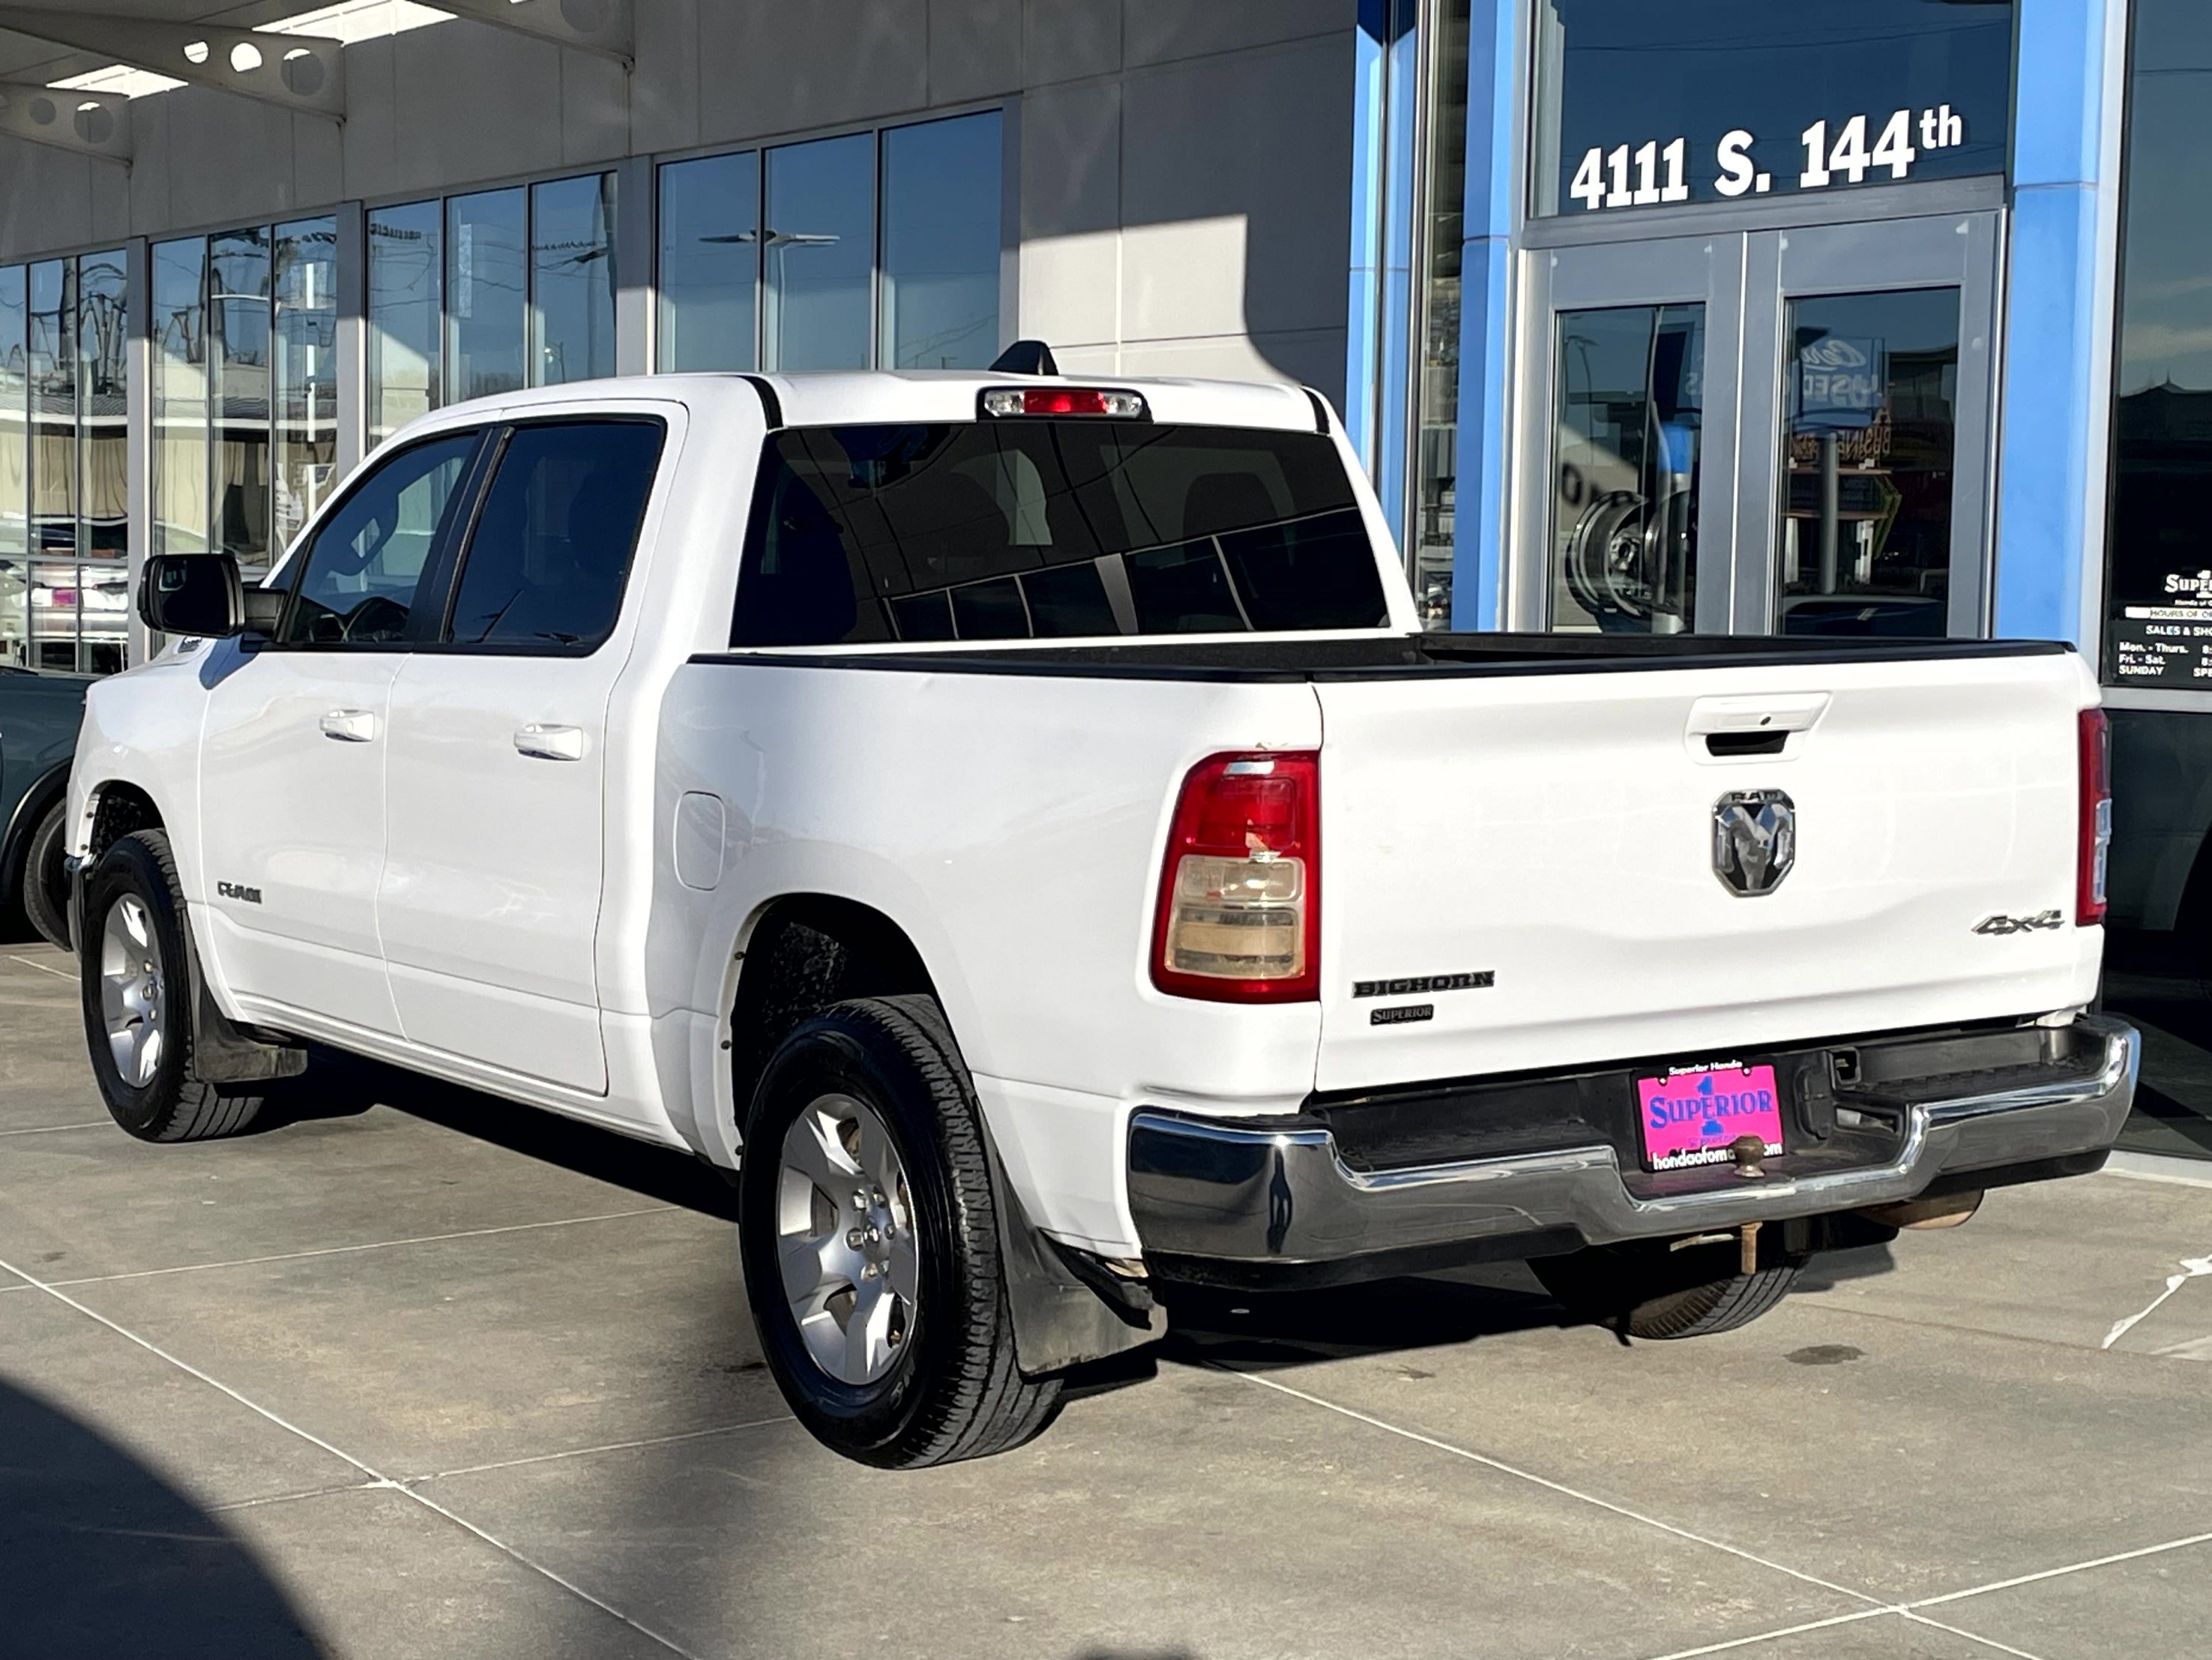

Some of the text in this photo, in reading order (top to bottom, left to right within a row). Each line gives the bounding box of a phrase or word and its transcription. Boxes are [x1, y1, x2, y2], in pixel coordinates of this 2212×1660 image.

[1570, 103, 1962, 210] 4111 S. 144th
[2145, 625, 2181, 636] SALES
[2119, 666, 2164, 675] SUNDAY
[217, 880, 262, 904] RAM
[1372, 1006, 1432, 1023] SUPERIOR
[1668, 1065, 1708, 1075] Superior
[1649, 1090, 1774, 1129] SUPERIOR
[1652, 1142, 1782, 1170] hondaofomaom
